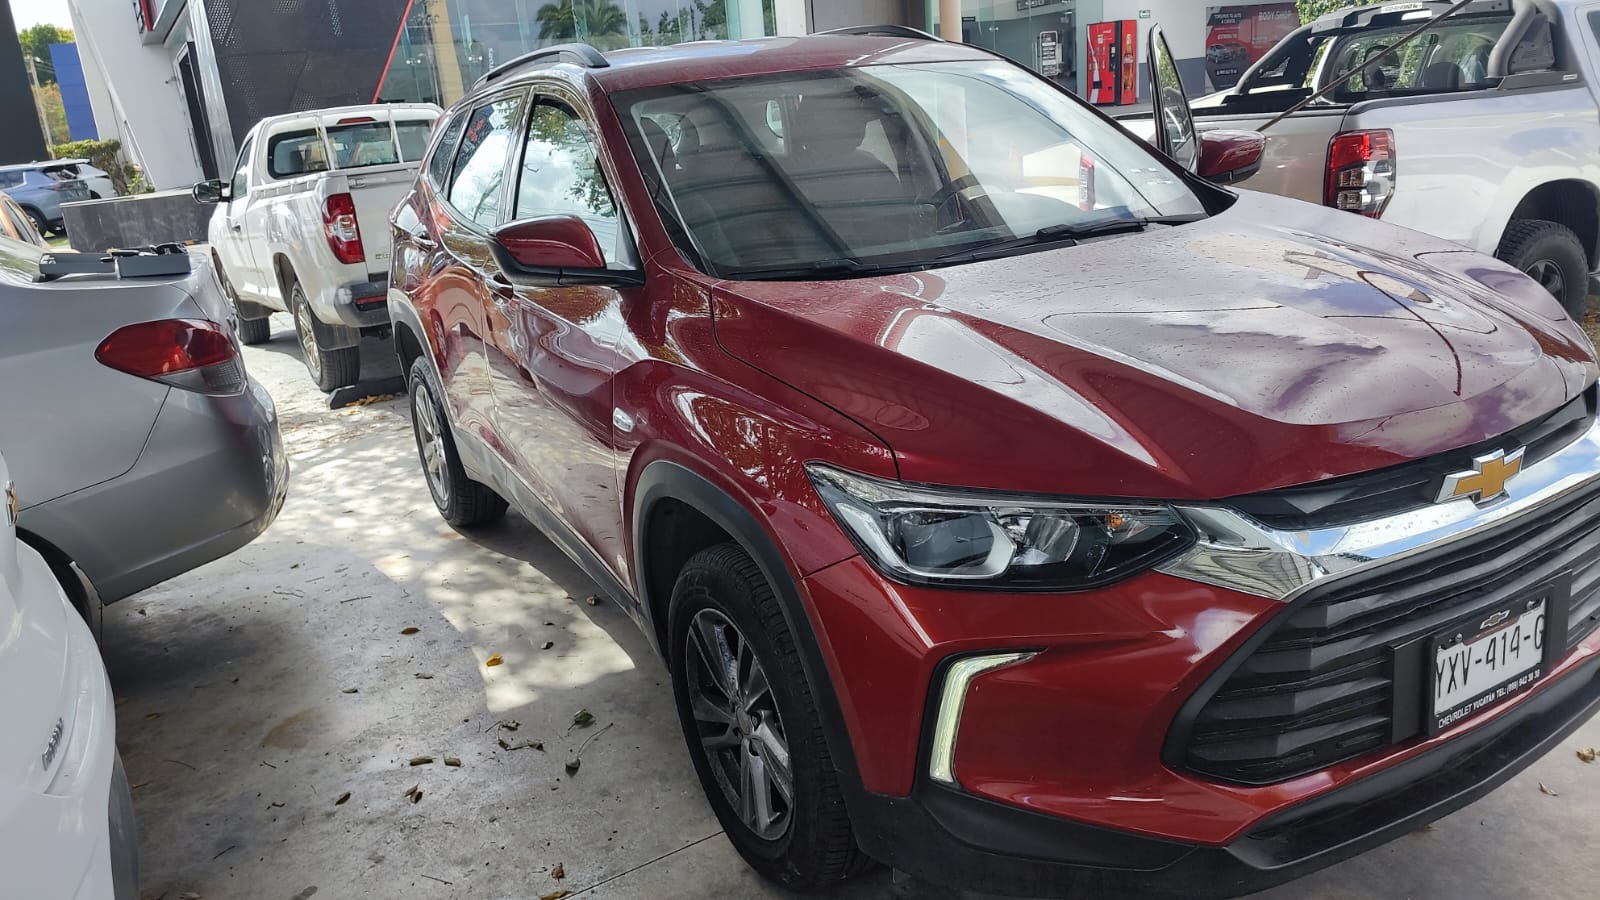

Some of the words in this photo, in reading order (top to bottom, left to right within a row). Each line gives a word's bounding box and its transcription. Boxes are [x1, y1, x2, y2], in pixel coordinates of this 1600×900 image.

[1258, 11, 1274, 21] BODY
[1436, 614, 1544, 699] YXV-414-G
[1438, 703, 1472, 729] CHEVROLET
[1473, 691, 1495, 710] YUCATÁN
